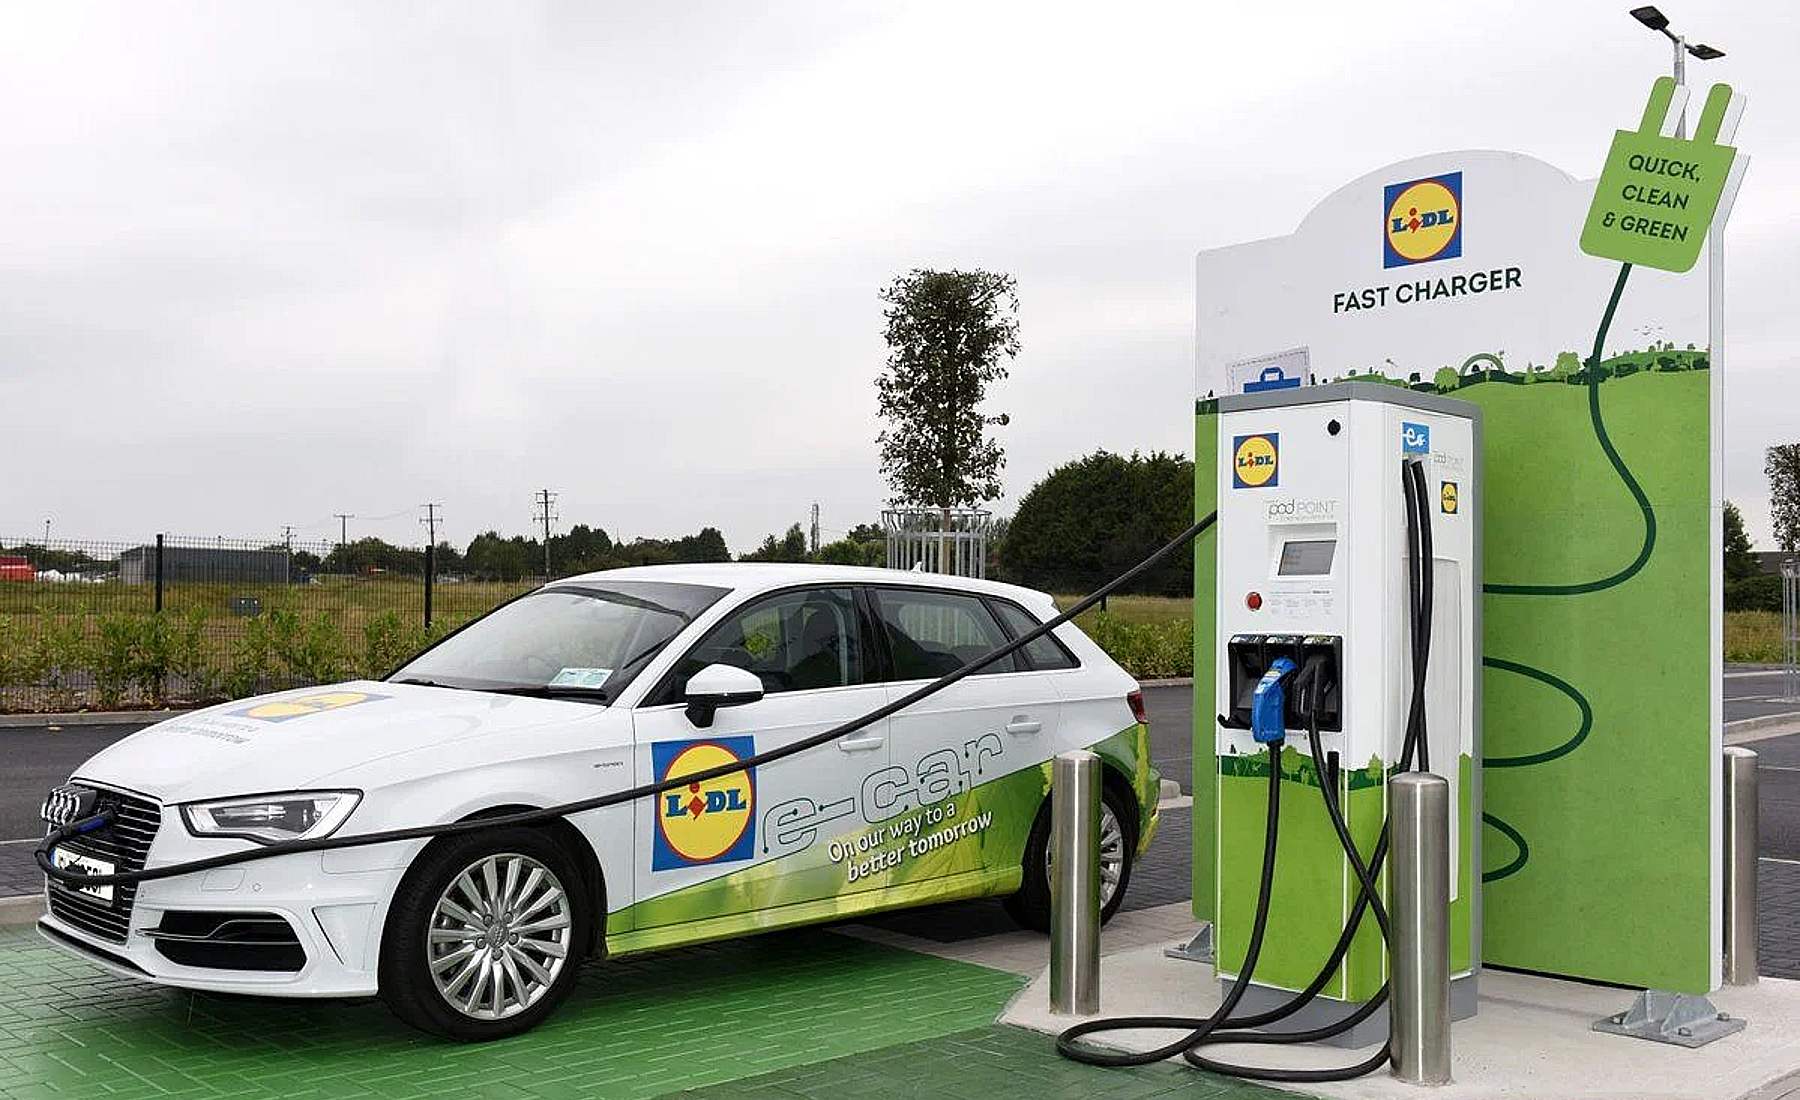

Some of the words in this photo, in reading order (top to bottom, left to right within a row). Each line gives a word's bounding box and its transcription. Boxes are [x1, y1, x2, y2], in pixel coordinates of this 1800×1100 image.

[1628, 154, 1700, 182] QUICK,
[1622, 184, 1690, 210] CLEAN
[1602, 211, 1616, 228] &
[1620, 215, 1689, 242] GREEN
[1333, 286, 1390, 314] FAST
[1395, 266, 1522, 304] CHARGER
[763, 733, 1003, 854] e-car
[828, 841, 855, 863] On
[858, 828, 886, 851] our
[890, 814, 922, 838] way
[926, 806, 942, 825] to
[946, 802, 957, 818] a
[847, 845, 905, 883] better
[909, 811, 993, 858] tomorrow
